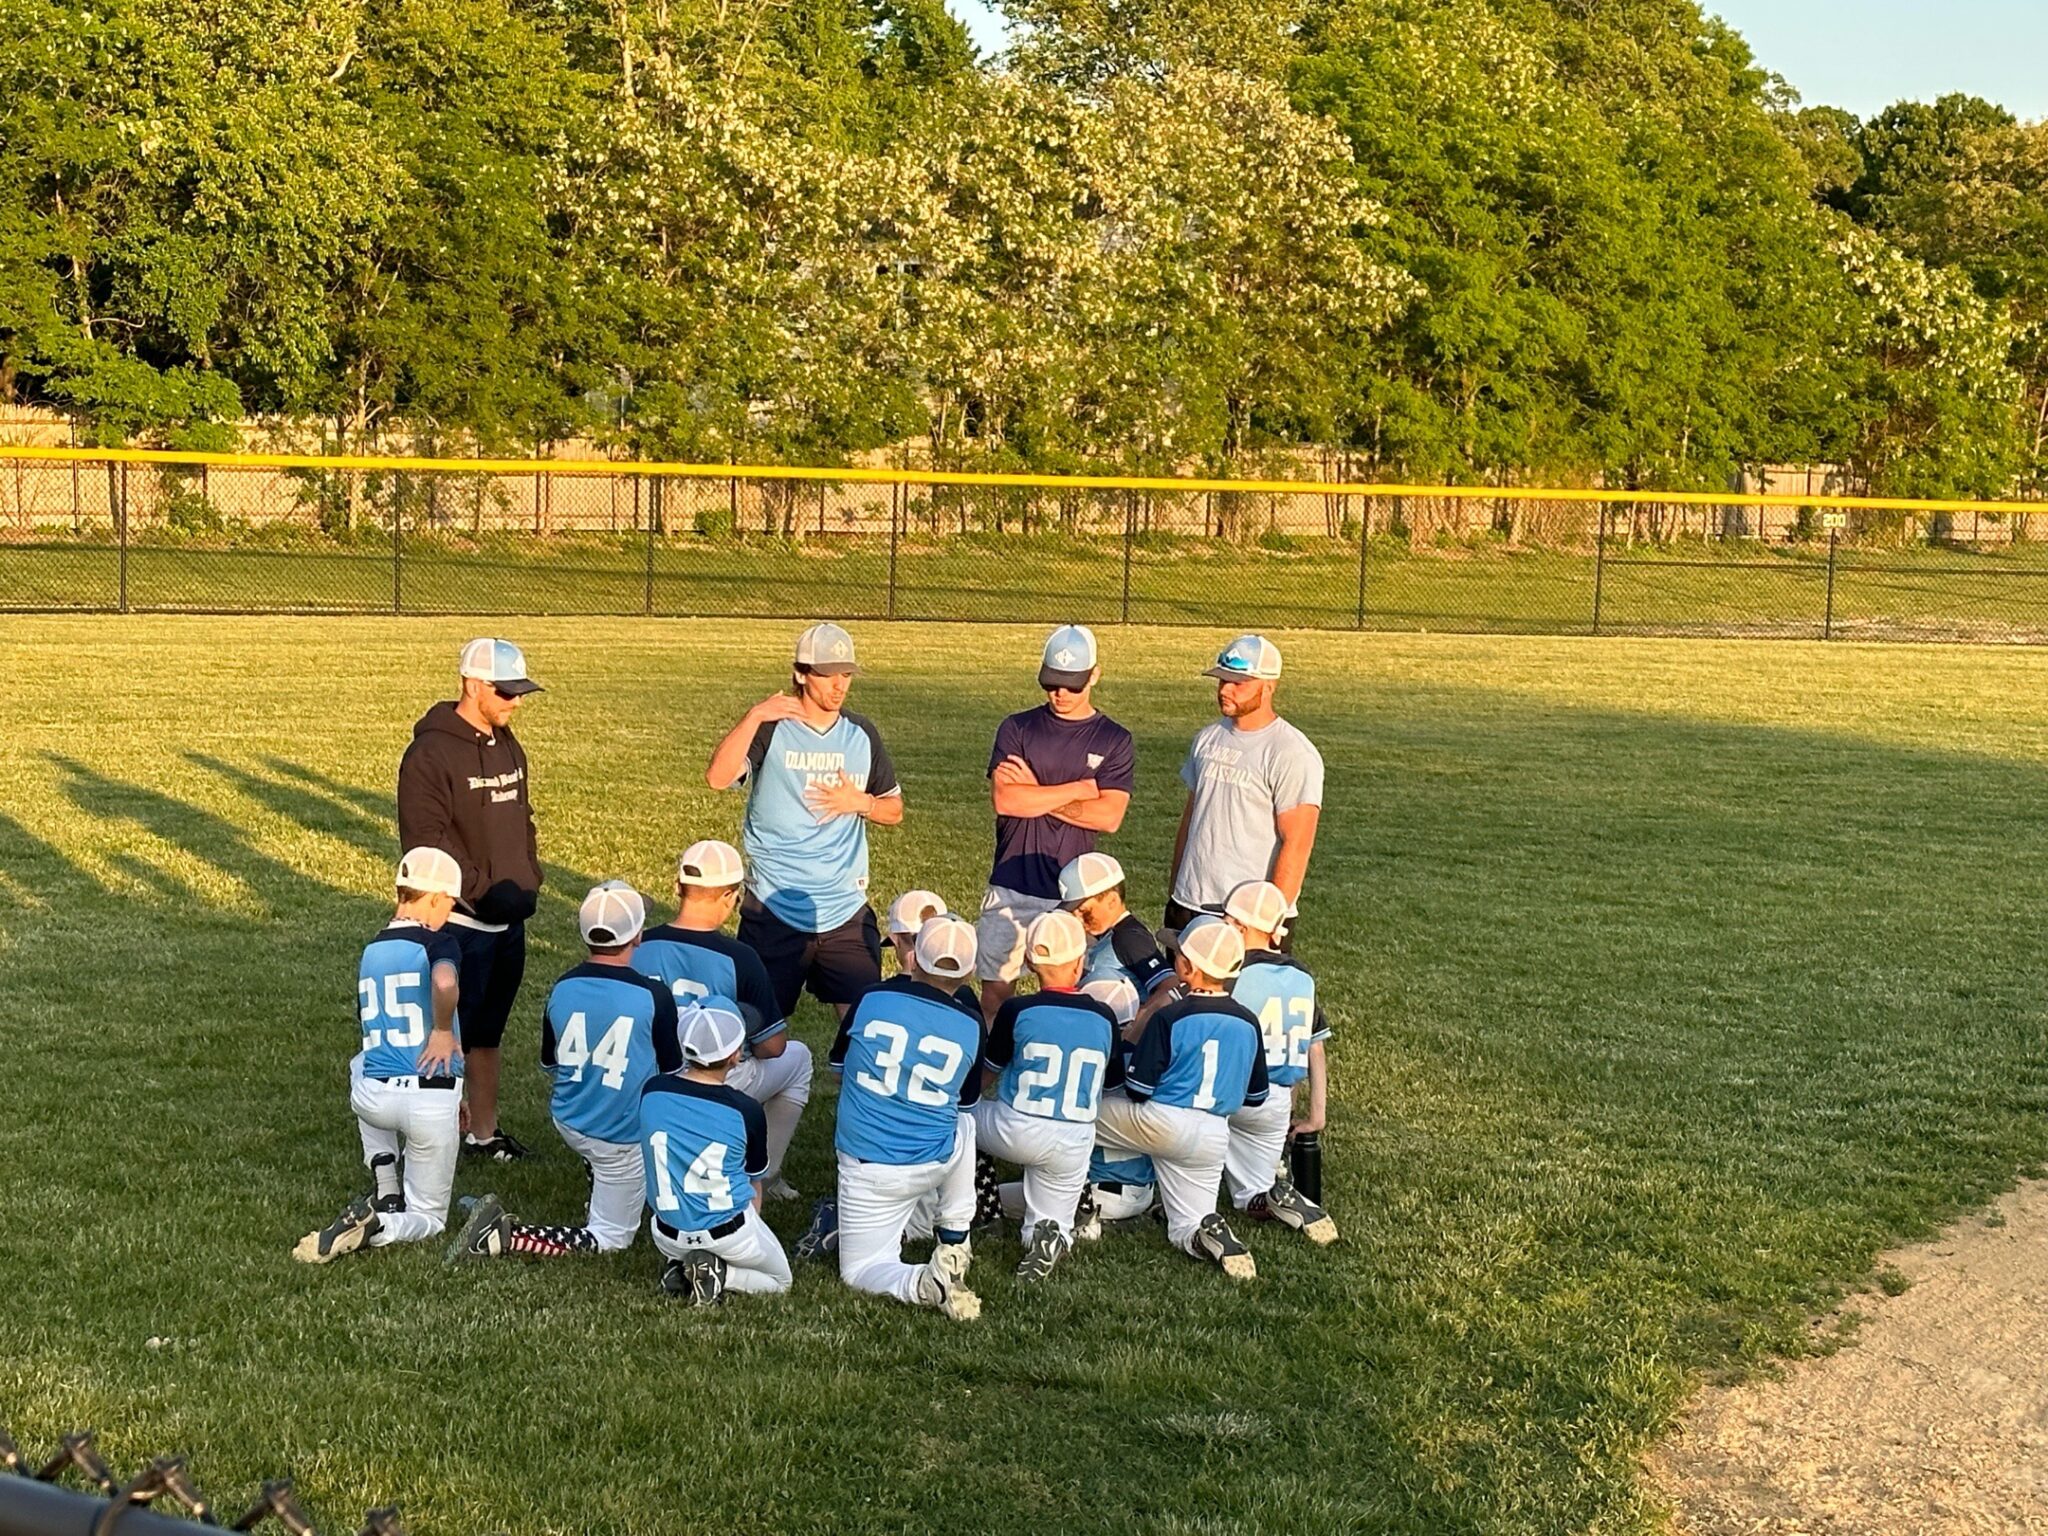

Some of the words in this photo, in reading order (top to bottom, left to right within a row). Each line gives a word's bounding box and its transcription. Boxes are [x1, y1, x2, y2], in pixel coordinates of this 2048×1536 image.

[1823, 514, 1846, 528] 200
[785, 750, 845, 772] DIAMOND
[804, 772, 867, 793] BASEALL
[359, 971, 425, 1052] 25
[1258, 996, 1314, 1067] 42
[557, 1012, 634, 1090] 44
[857, 1020, 963, 1106] 32
[1013, 1042, 1105, 1122] 20
[1193, 1039, 1219, 1109] 1
[650, 1131, 733, 1211] 14
